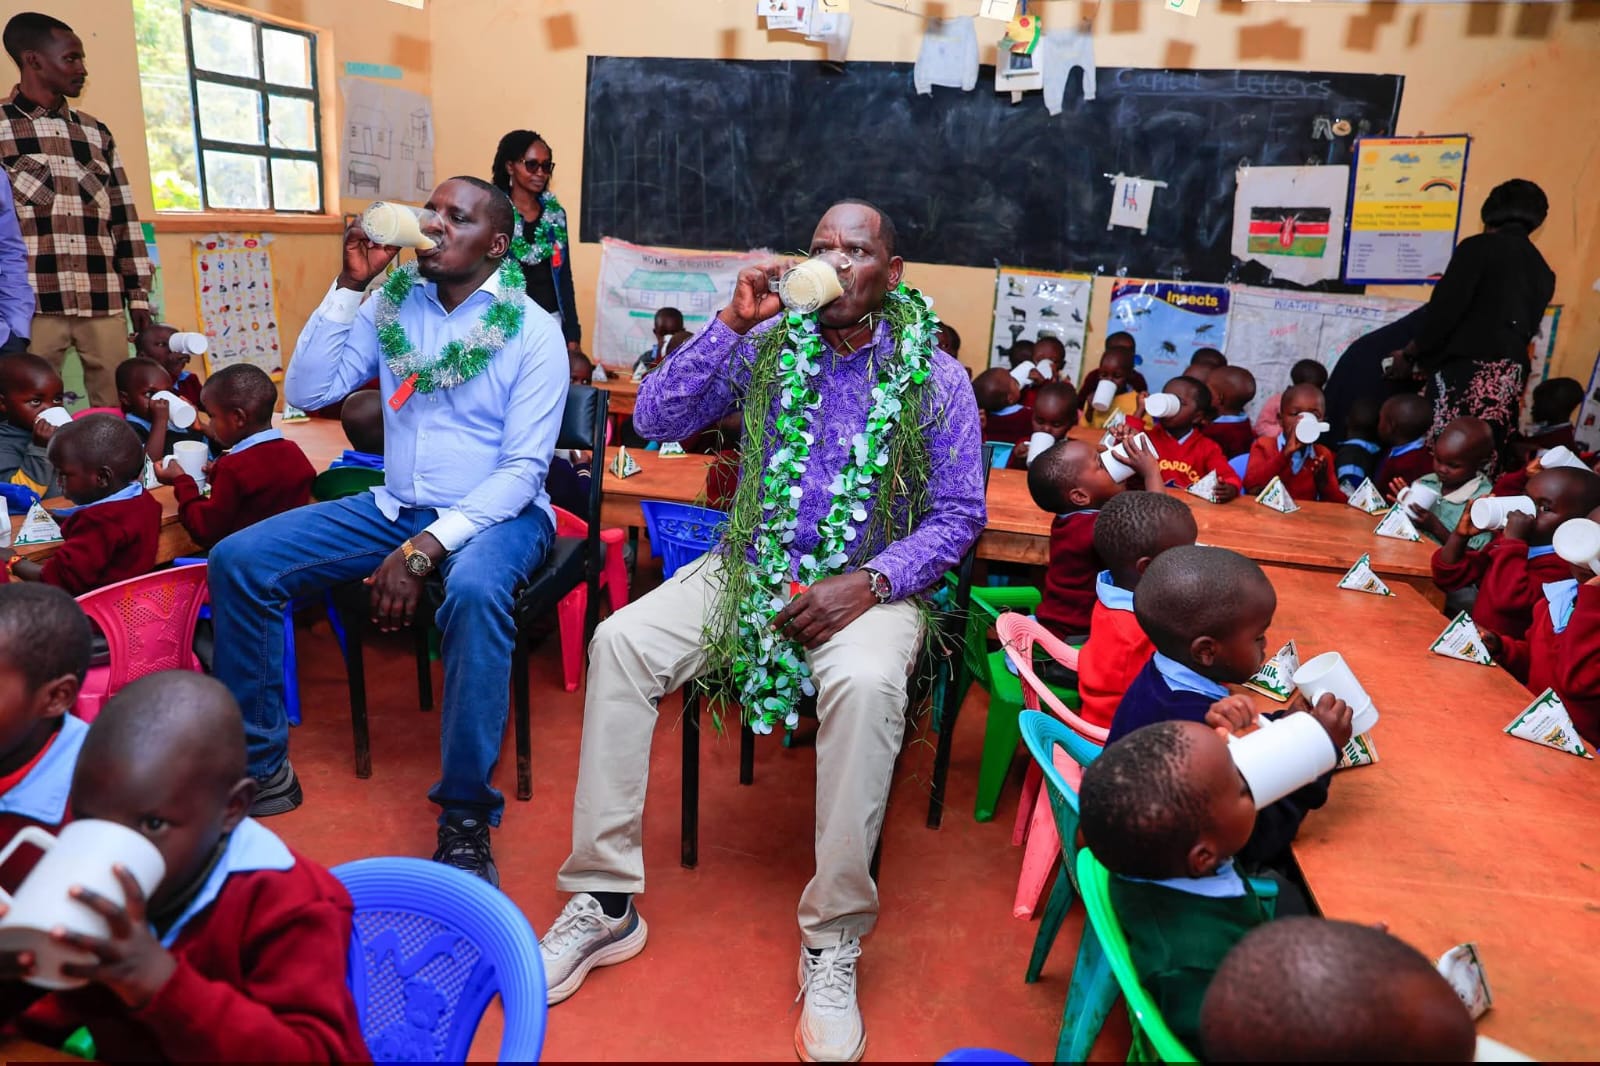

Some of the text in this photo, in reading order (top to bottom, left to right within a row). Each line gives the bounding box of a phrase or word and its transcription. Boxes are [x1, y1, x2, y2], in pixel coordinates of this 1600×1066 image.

[1116, 69, 1331, 96] Capital Letters
[1167, 290, 1218, 307] Insects
[1334, 303, 1381, 317] CHART
[1260, 664, 1278, 680] ilk
[1345, 742, 1360, 766] Mil
